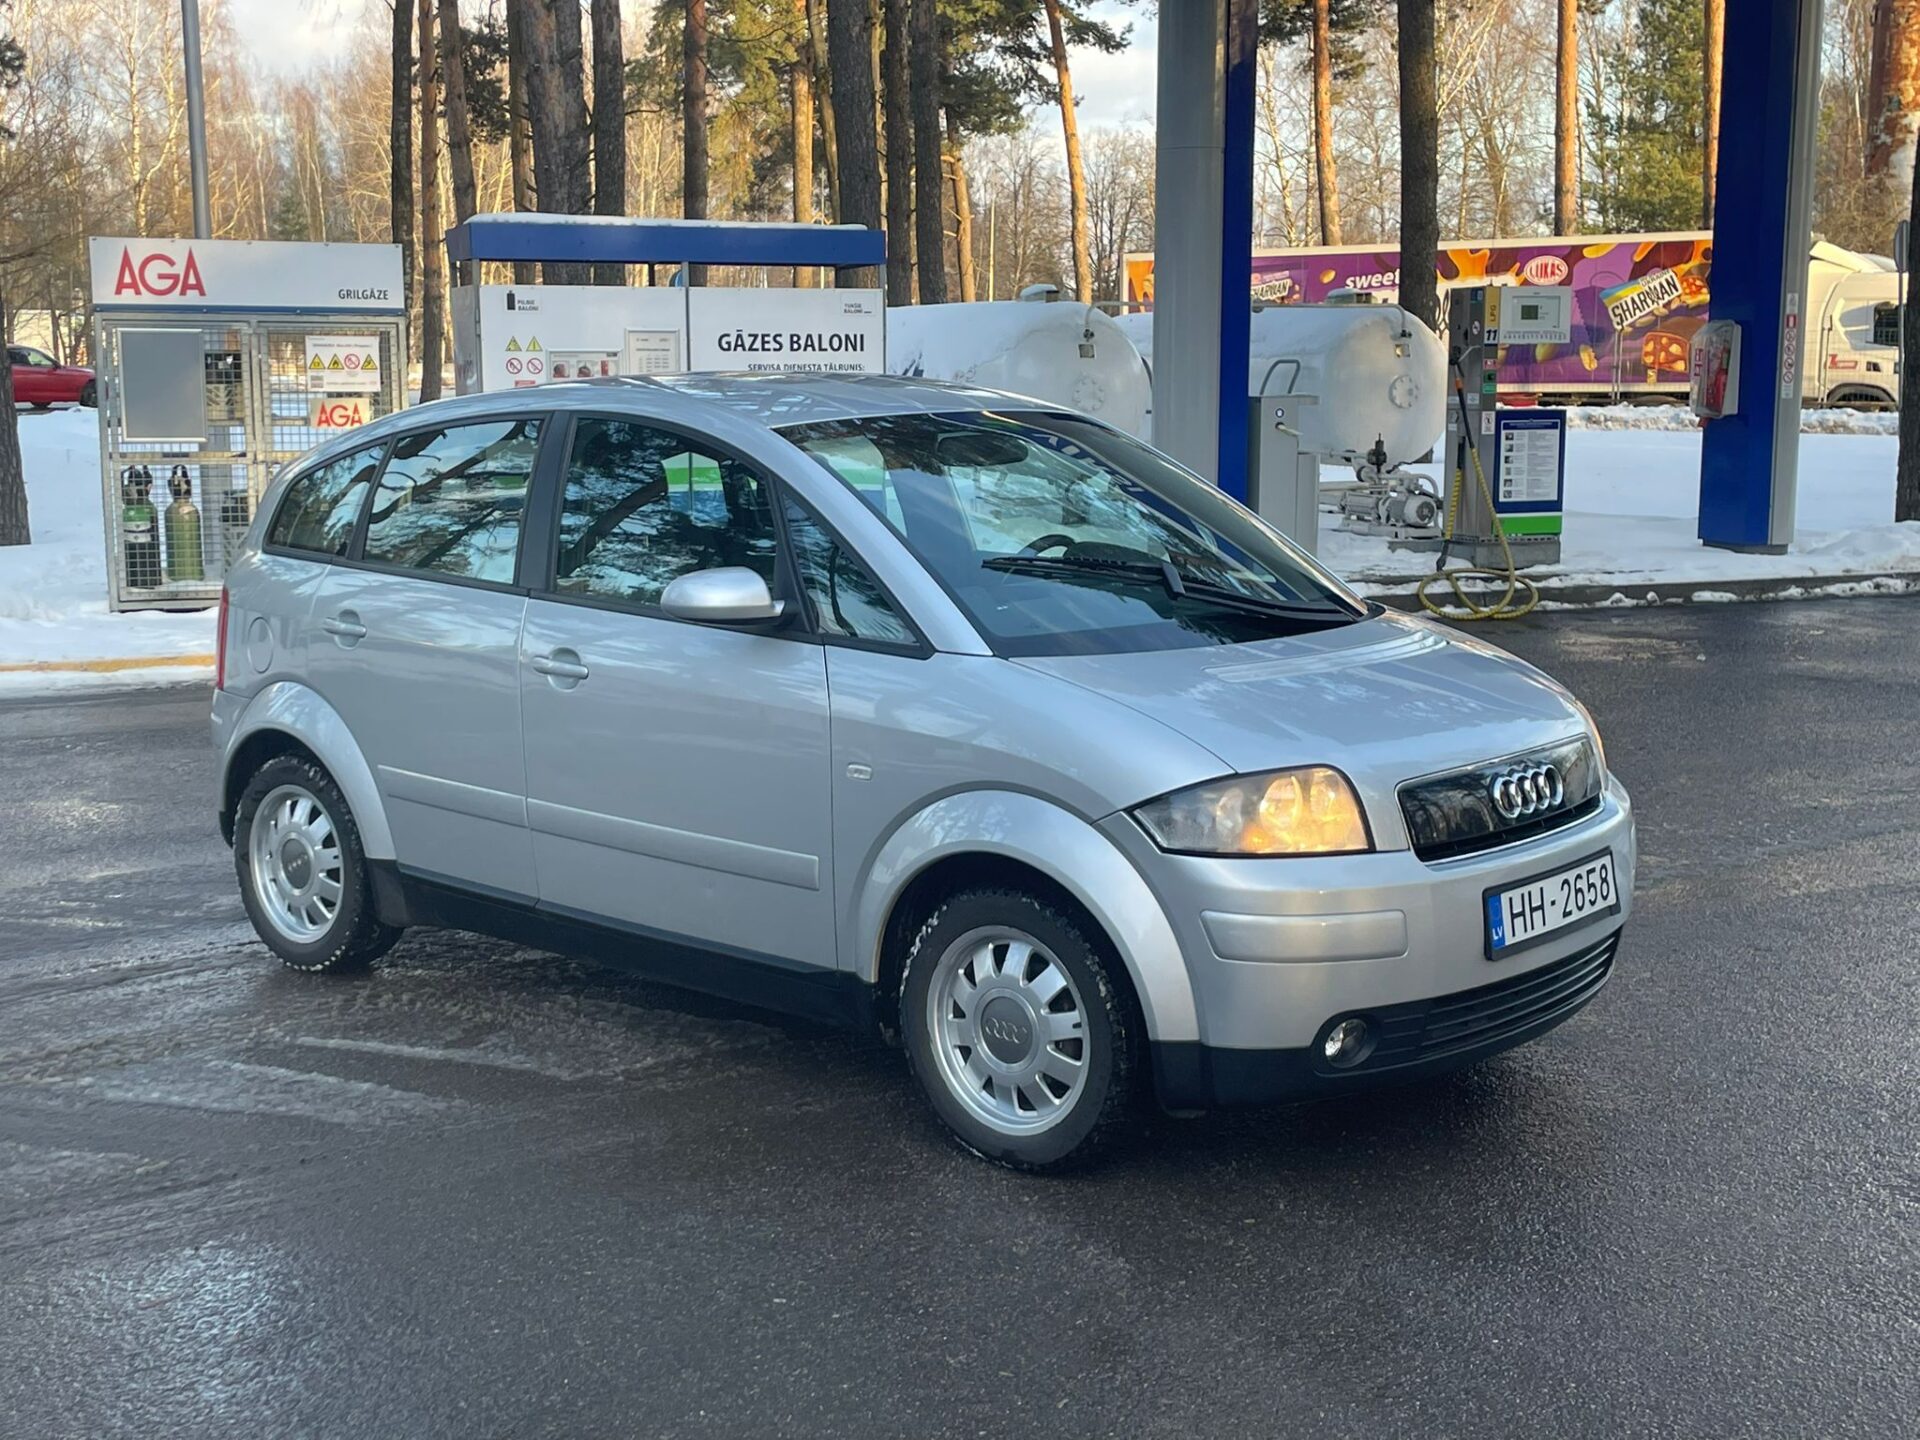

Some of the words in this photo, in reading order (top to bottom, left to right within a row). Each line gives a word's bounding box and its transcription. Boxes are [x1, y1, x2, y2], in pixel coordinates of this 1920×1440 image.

[114, 244, 207, 296] AGA
[1529, 262, 1564, 279] LUKAS
[338, 287, 389, 300] GRILGĀZE
[1611, 274, 1681, 327] SHARMAN
[718, 329, 783, 352] GĀZES
[789, 333, 865, 352] BALONI
[1485, 329, 1498, 341] 11
[747, 363, 782, 371] SERVISA
[784, 363, 822, 371] DIENESTA
[316, 400, 363, 427] AGA
[1508, 863, 1610, 938] HH-2658
[1491, 925, 1504, 941] LV
